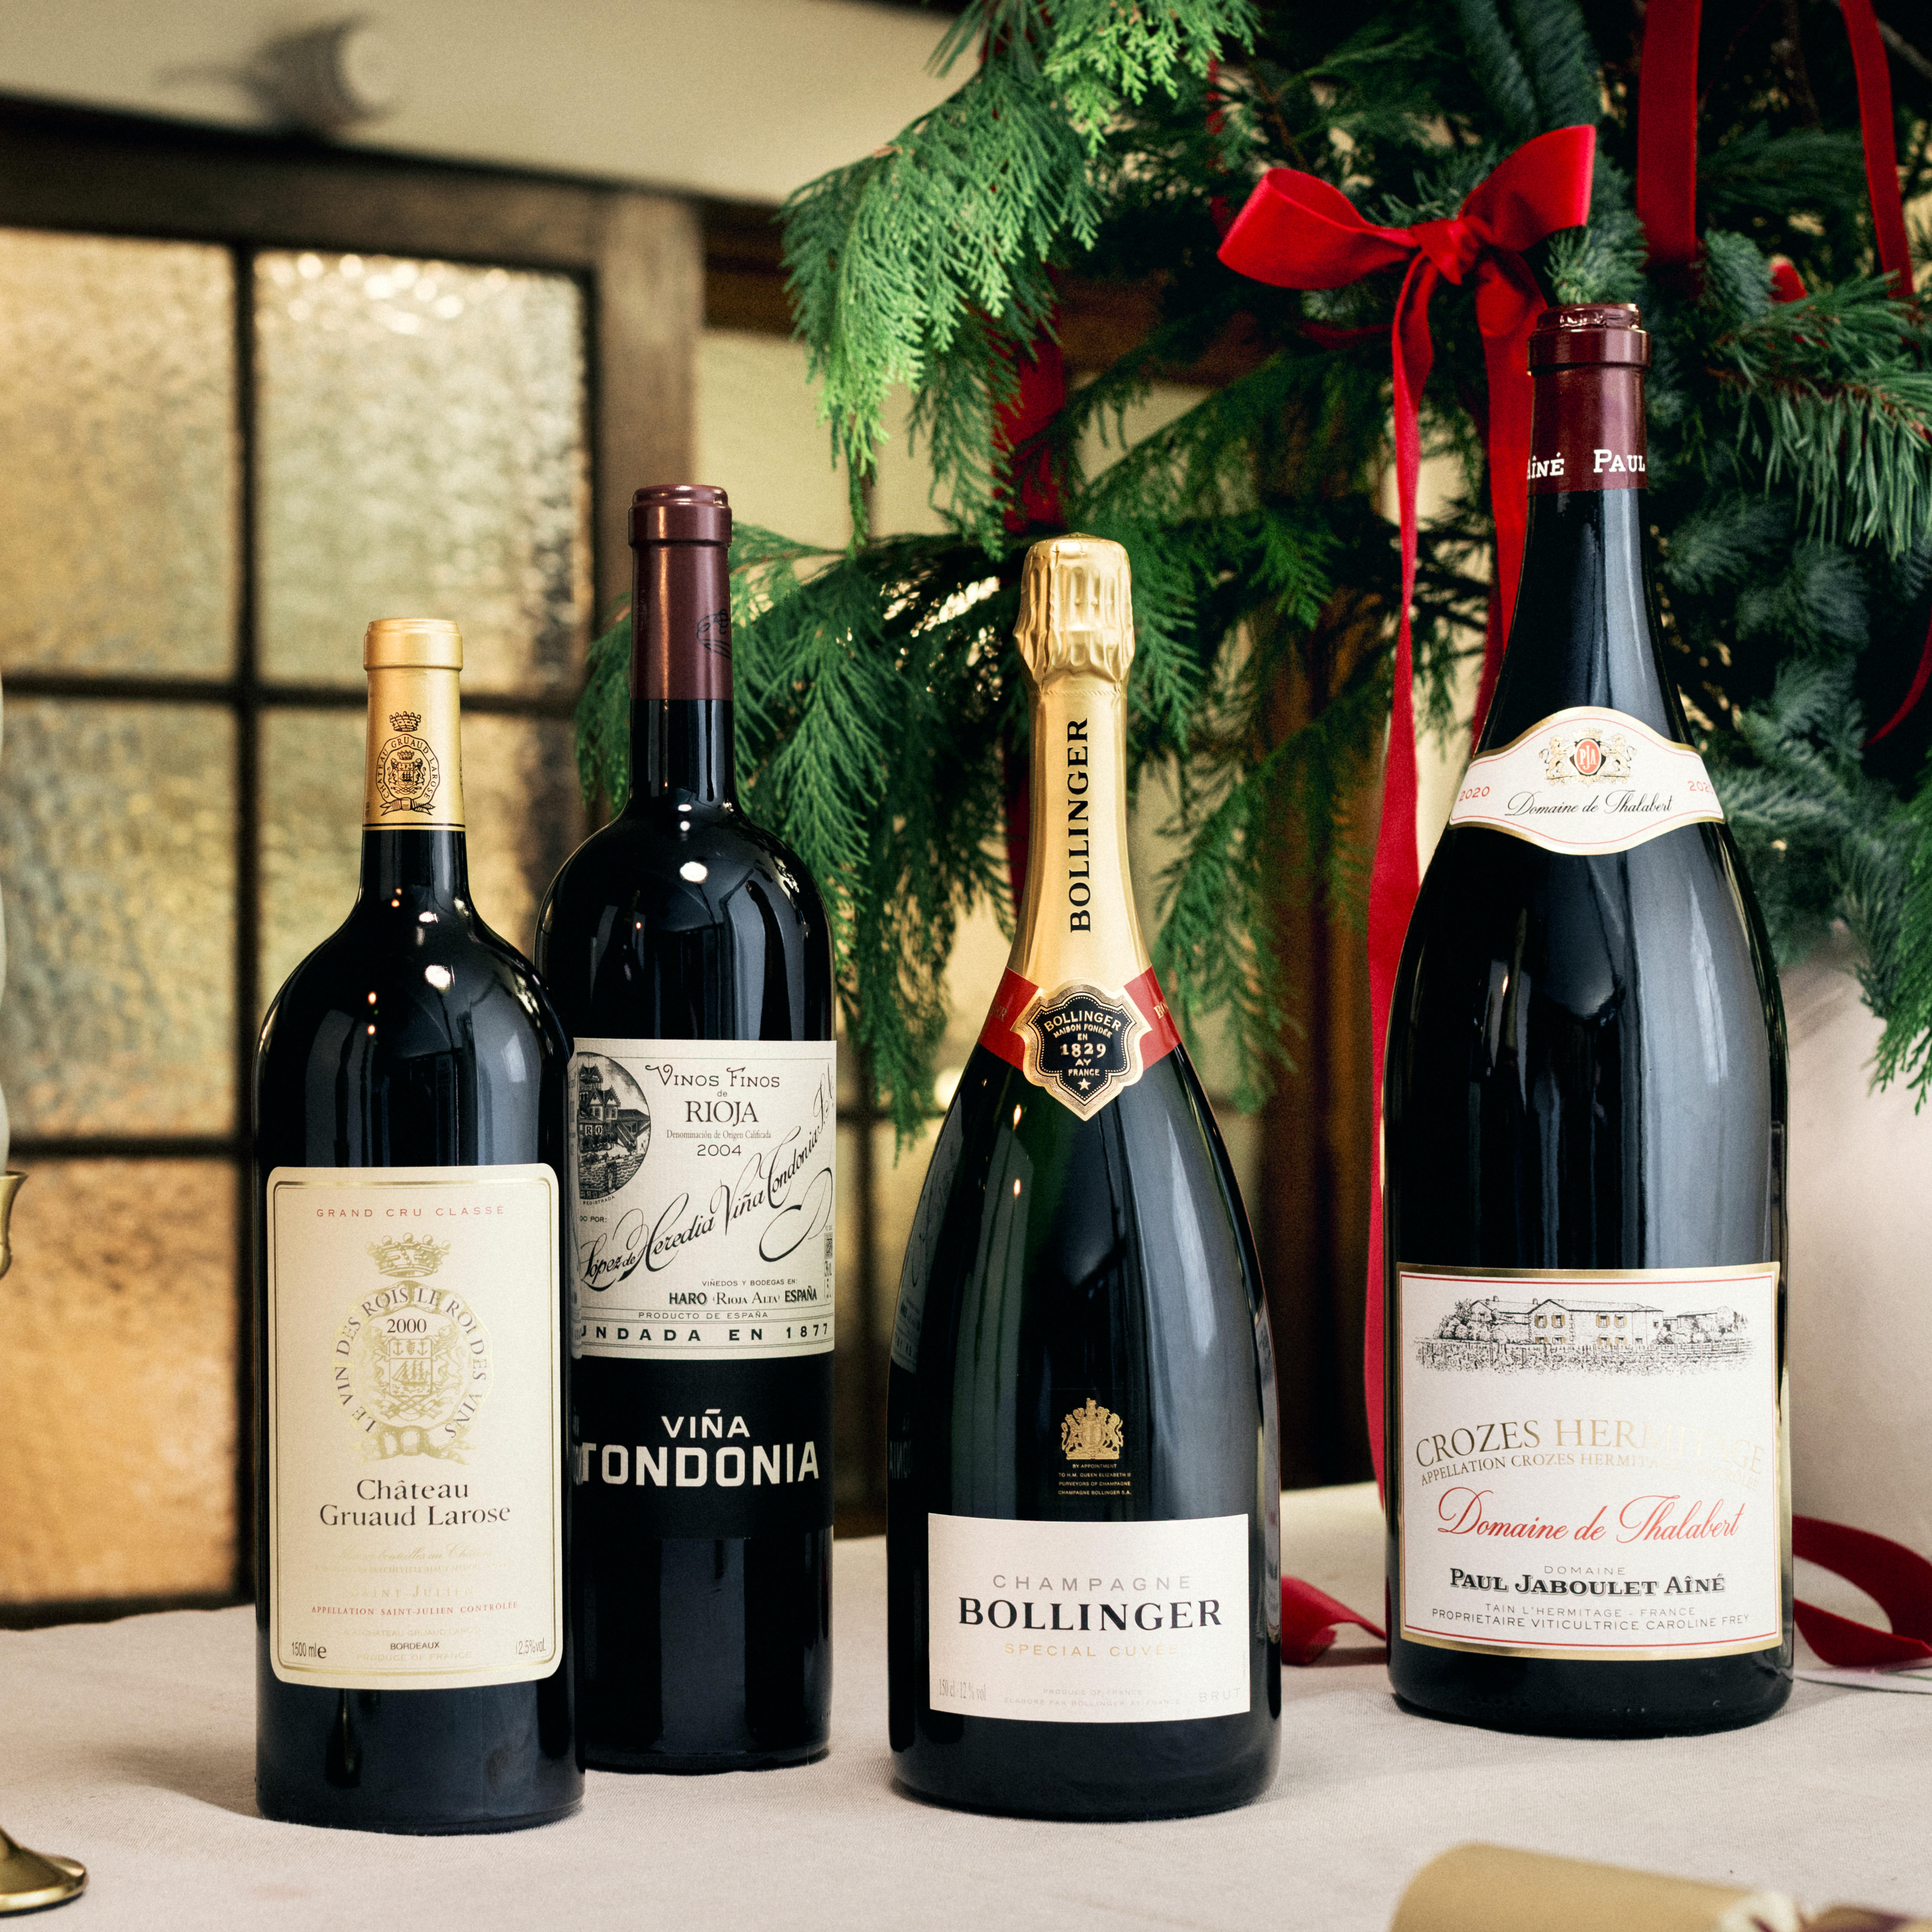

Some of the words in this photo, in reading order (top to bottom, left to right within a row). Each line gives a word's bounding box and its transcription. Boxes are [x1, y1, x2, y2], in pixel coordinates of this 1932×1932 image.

[377, 748, 389, 799] CHATEAU
[391, 737, 429, 754] GRUAUD
[424, 758, 437, 799] LAROSE
[1459, 786, 1490, 801] 2020
[1504, 791, 1580, 816] Domaine
[1582, 795, 1599, 813] de
[1604, 790, 1673, 814] Thalabert
[1068, 718, 1091, 932] BOLLINGER
[1044, 1010, 1121, 1032] BOLLINGER
[1053, 1024, 1081, 1038] MAISON
[1084, 1024, 1113, 1039] FONDÉE
[1061, 1043, 1106, 1058] 1829
[685, 1100, 759, 1126] RIOJA
[667, 1130, 712, 1139] Denominación
[714, 1130, 721, 1139] de
[723, 1130, 743, 1140] Origen
[745, 1129, 771, 1139] Calificada
[698, 1145, 741, 1156] 2004
[316, 1209, 373, 1217] GRAND
[387, 1208, 422, 1217] CRU
[436, 1205, 504, 1216] CLASSÉ
[583, 1196, 615, 1205] REGISTRADA
[361, 1287, 409, 1317] ROIS
[418, 1287, 441, 1307] LE
[669, 1292, 707, 1305] HARO
[784, 1286, 817, 1302] ESPAÑA
[387, 1318, 427, 1333] 2000
[447, 1300, 477, 1333] ROI
[336, 1318, 361, 1356] DES
[729, 1329, 762, 1341] EN
[786, 1323, 827, 1338] 1877
[472, 1338, 486, 1381] DES
[335, 1366, 352, 1407] VIN
[352, 1407, 377, 1433] LE
[445, 1395, 483, 1438] VINS
[661, 1409, 750, 1438] VIÑA
[1416, 1420, 1542, 1468] CROZES
[1553, 1419, 1765, 1475] HERMITAGE
[582, 1441, 819, 1487] TONDONIA
[1421, 1457, 1507, 1486] APPELLATION
[1511, 1453, 1574, 1467] CROZES
[1580, 1453, 1680, 1472] HERMITAGE
[357, 1479, 468, 1500] Château
[320, 1505, 415, 1526] Gruaud
[428, 1505, 510, 1525] Larose
[1437, 1486, 1568, 1540] Domaine
[1574, 1505, 1607, 1540] de
[1616, 1494, 1745, 1543] Thalabert
[1544, 1566, 1626, 1575] DOMAINE
[993, 1575, 1190, 1591] CHAMPAGNE
[1450, 1568, 1509, 1591] PAUL
[1515, 1574, 1659, 1596] JABOULET
[1664, 1573, 1725, 1594] AÎNÉ
[312, 1606, 374, 1615] APPELLATION
[381, 1607, 453, 1615] SAINT-JULIEN
[460, 1601, 518, 1613] CONTRÔLÉE
[958, 1597, 1222, 1631] BOLLINGER
[1485, 1603, 1515, 1613] TAIN
[1523, 1606, 1622, 1617] L'HERMITAGE
[1640, 1607, 1695, 1617] FRANCE
[1432, 1608, 1525, 1627] PROPRIETAIRE
[1531, 1619, 1639, 1630] VITICULTRICE
[1646, 1618, 1717, 1630] CAROLINE
[1722, 1613, 1750, 1625] FREY
[292, 1642, 306, 1656] 1500
[390, 1641, 440, 1650] BORDEAUX
[1005, 1643, 1096, 1657] SPECIAL
[1110, 1640, 1178, 1657] CUVÉE
[939, 1679, 949, 1696] 150
[960, 1682, 966, 1698] 12
[977, 1684, 986, 1701] vol
[1199, 1688, 1241, 1703] BRUT
